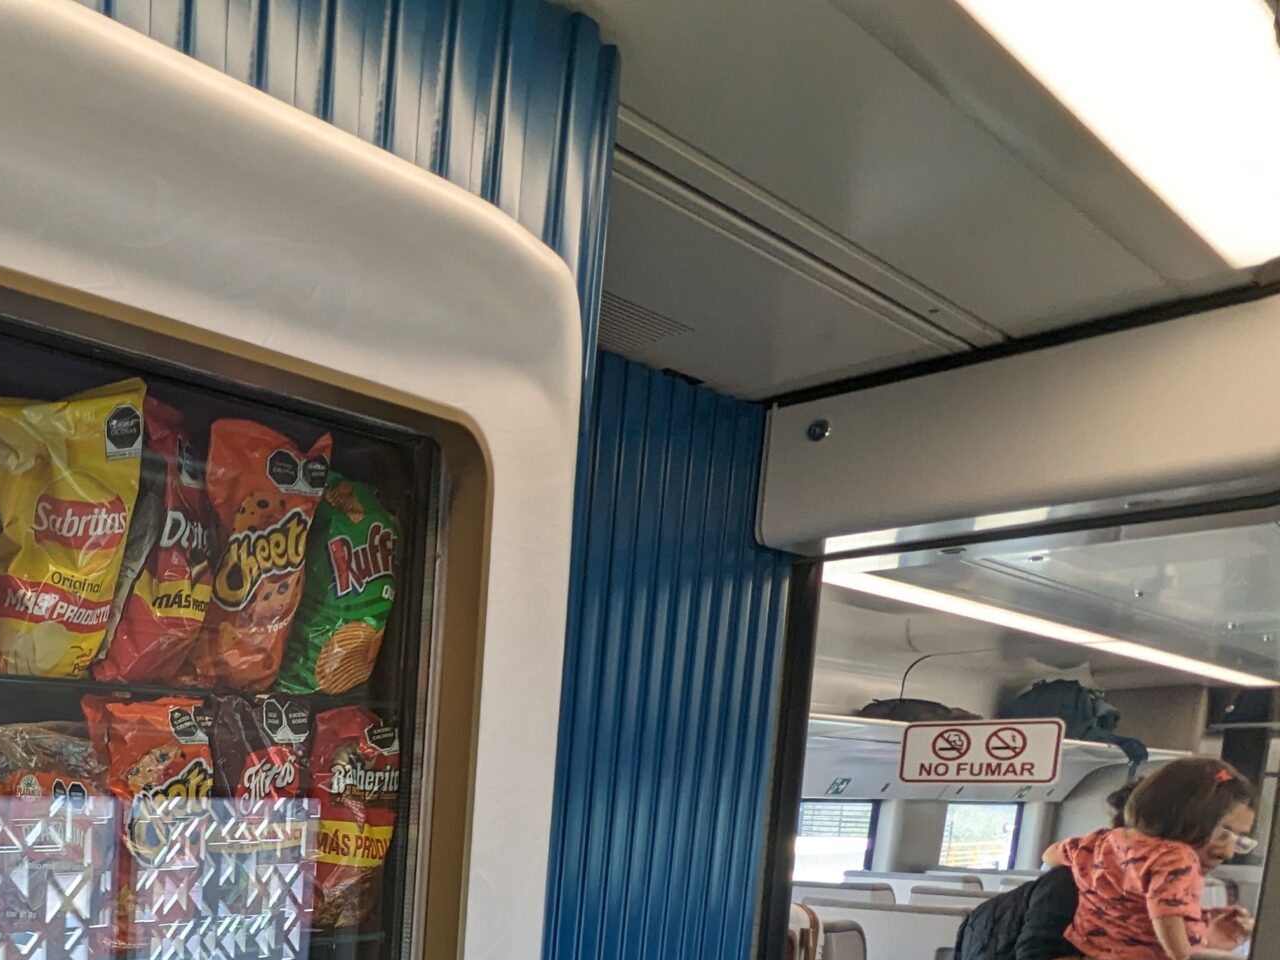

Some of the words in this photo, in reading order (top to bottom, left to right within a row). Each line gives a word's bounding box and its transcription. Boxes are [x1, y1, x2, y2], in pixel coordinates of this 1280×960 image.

[33, 501, 127, 539] Sabritas
[328, 523, 396, 596] Ruff
[50, 571, 103, 594] Original
[919, 762, 949, 777] NO
[956, 762, 1035, 777] FUMAR
